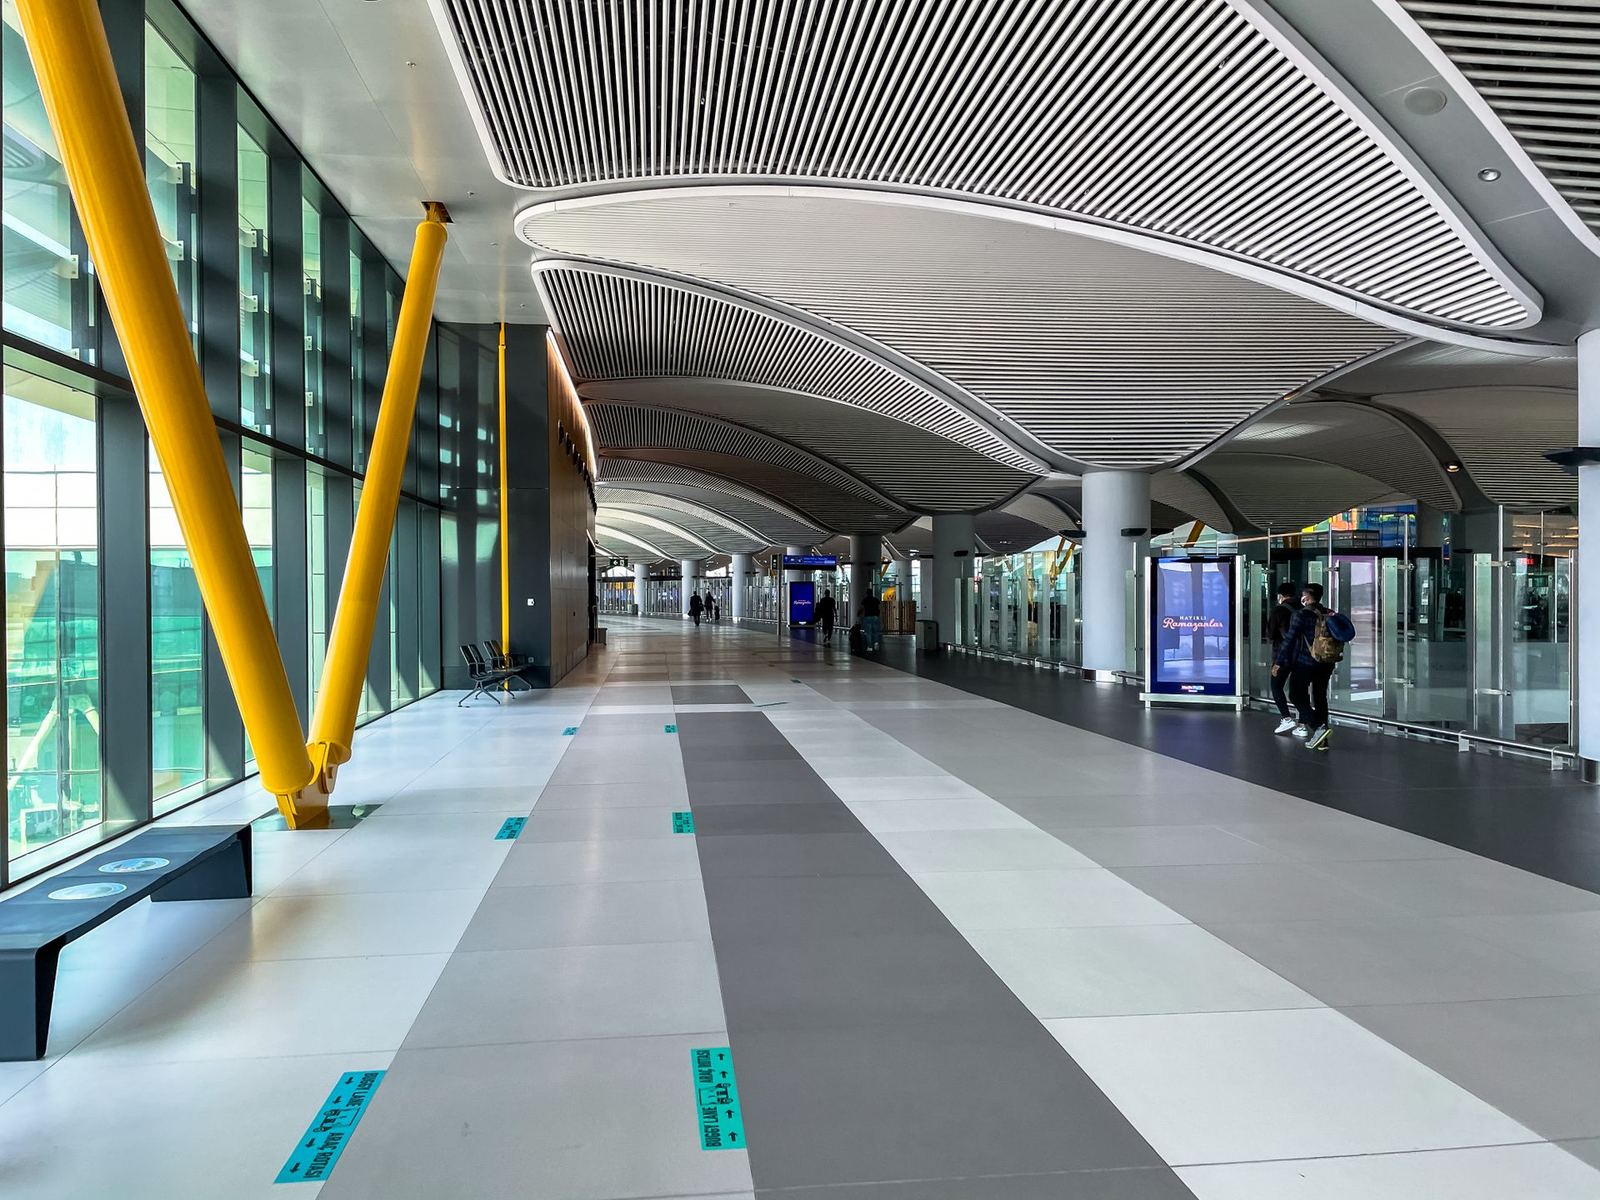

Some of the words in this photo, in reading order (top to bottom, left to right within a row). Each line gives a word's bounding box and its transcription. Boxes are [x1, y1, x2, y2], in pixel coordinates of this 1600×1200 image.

[1163, 618, 1223, 631] Ramazanlar
[357, 1072, 379, 1090] BUGGY
[345, 1091, 368, 1107] LANE
[702, 1106, 719, 1123] LANE
[703, 1125, 722, 1147] BUGGY
